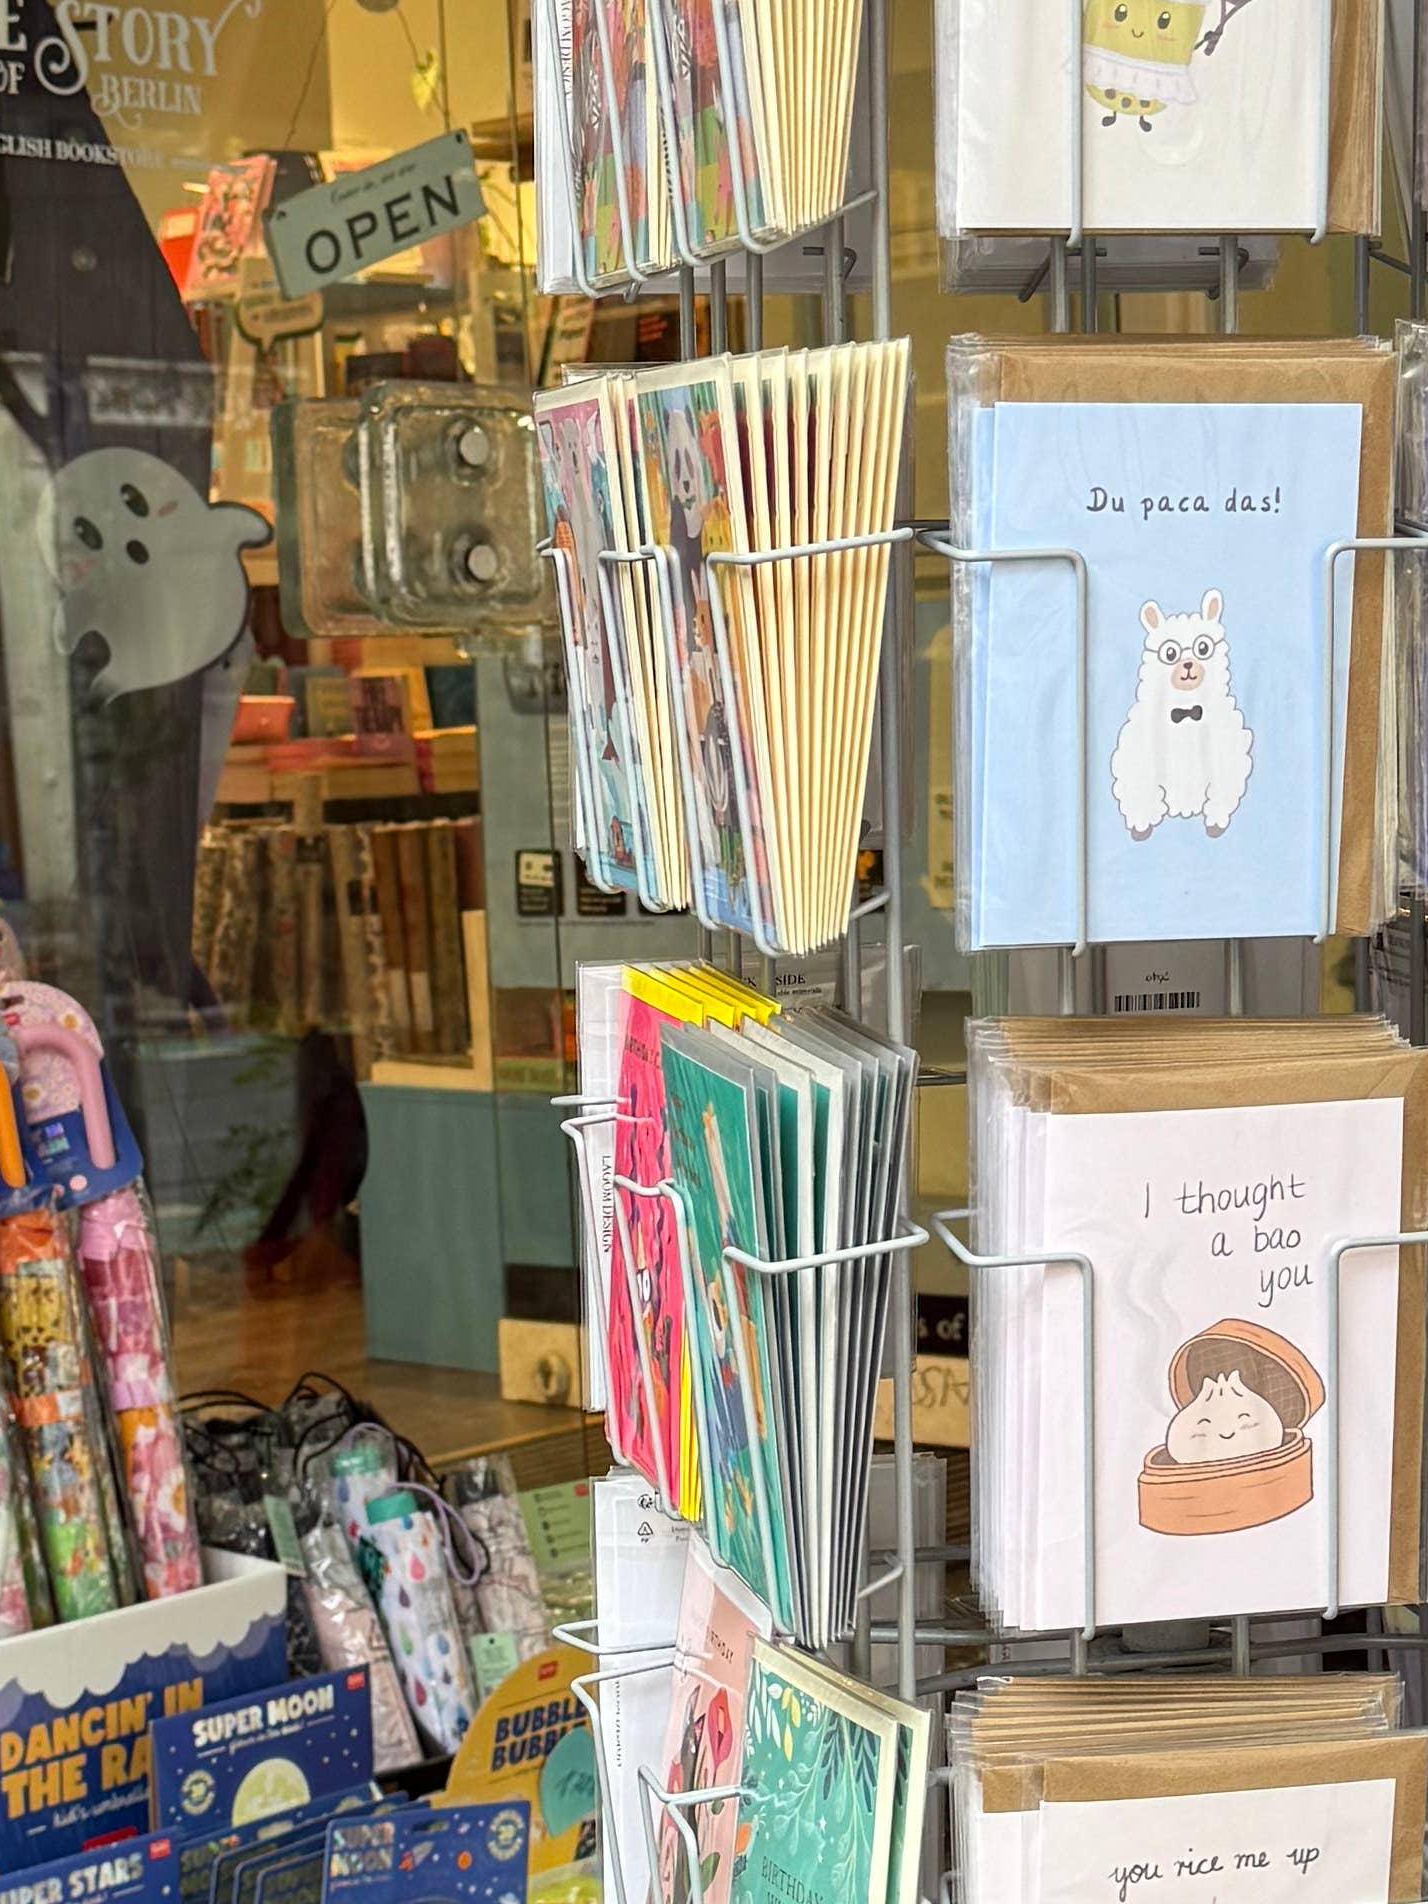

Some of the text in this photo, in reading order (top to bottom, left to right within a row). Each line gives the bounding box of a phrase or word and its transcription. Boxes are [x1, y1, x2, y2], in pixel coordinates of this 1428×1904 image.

[91, 73, 202, 130] BERLIN
[56, 139, 162, 169] BOOKSTORE
[305, 175, 461, 274] OPEN
[1086, 484, 1282, 519] Du paca das!
[1176, 1175, 1306, 1222] thought
[601, 1203, 612, 1253] DESIGN
[1210, 1223, 1302, 1256] a bao
[1259, 1260, 1313, 1307] you
[936, 1312, 965, 1341] of
[192, 1710, 264, 1748] SUPER
[266, 1685, 334, 1726] MOON
[495, 1697, 588, 1744] BUBBLE
[68, 1853, 144, 1898] STARS
[1108, 1843, 1320, 1904] you rice me up
